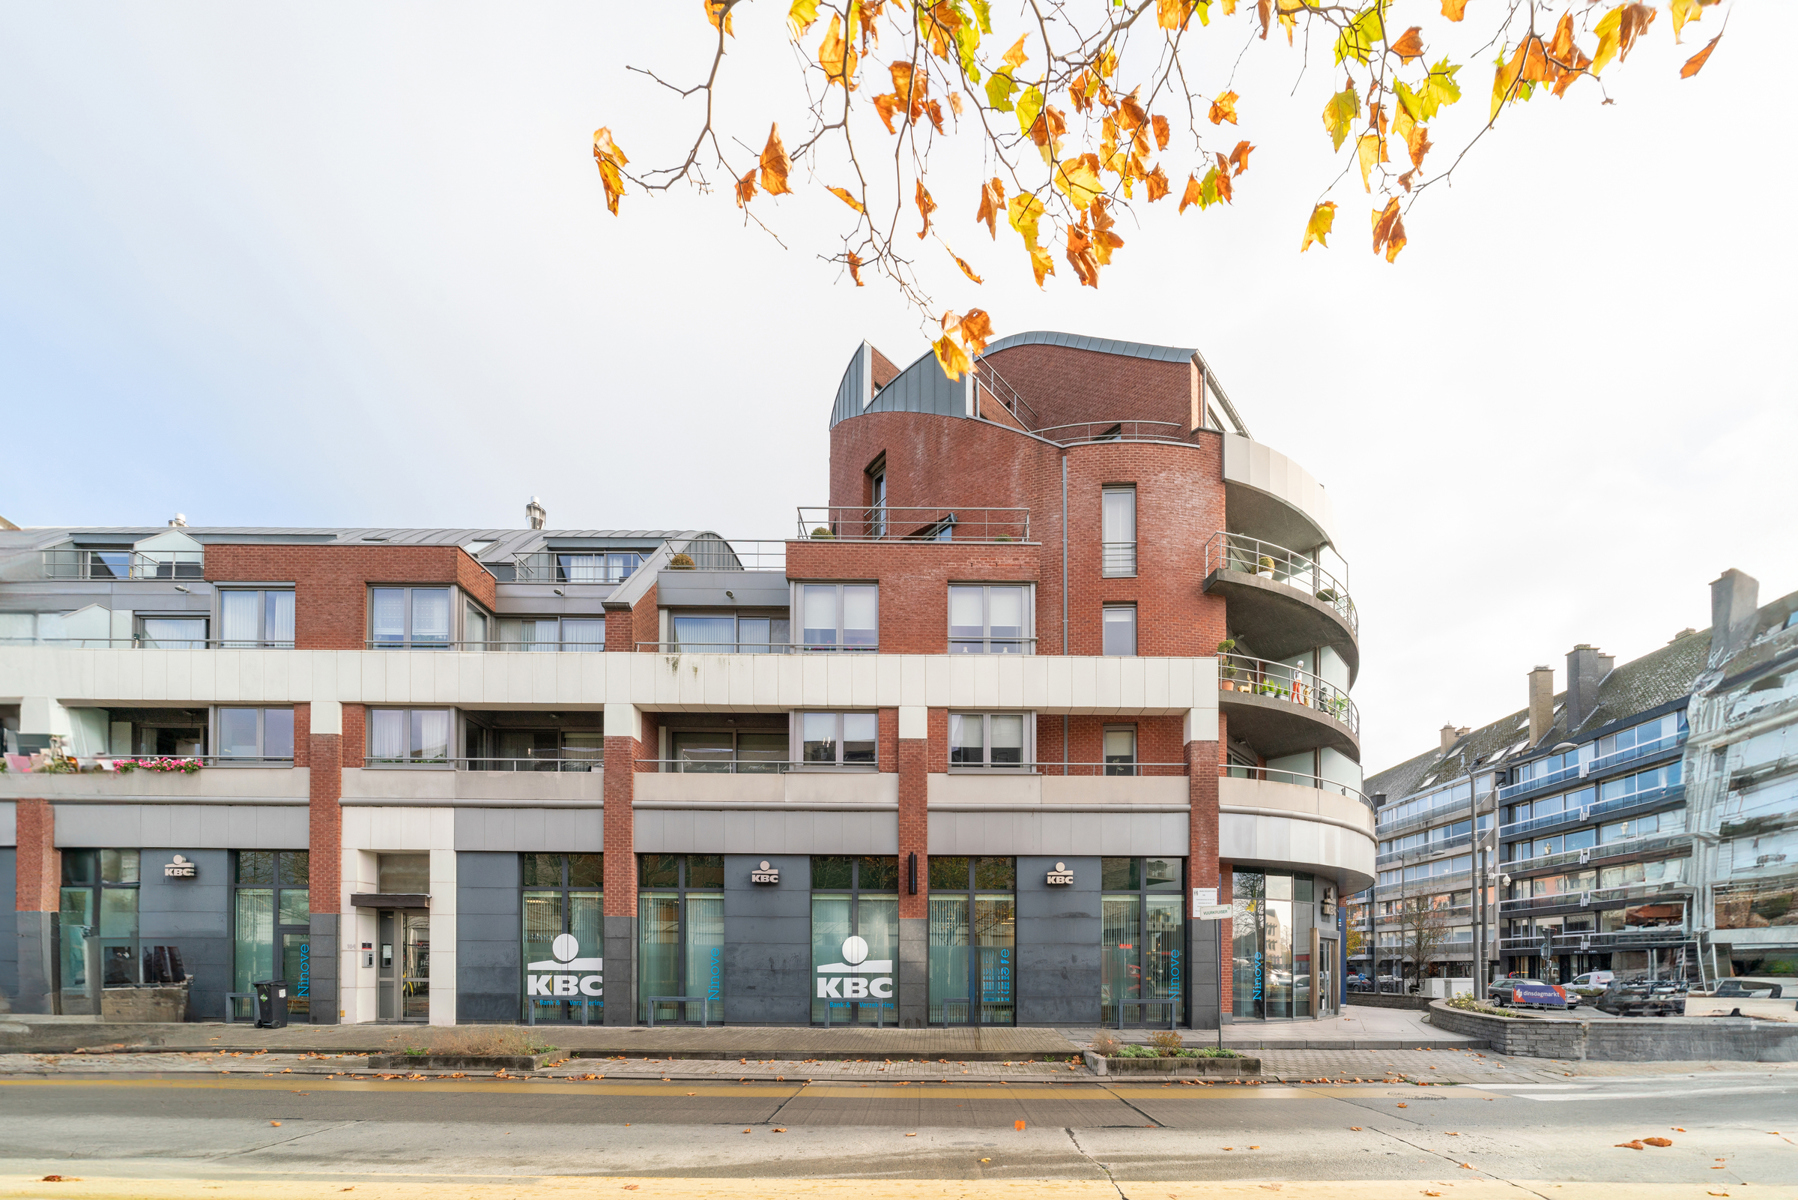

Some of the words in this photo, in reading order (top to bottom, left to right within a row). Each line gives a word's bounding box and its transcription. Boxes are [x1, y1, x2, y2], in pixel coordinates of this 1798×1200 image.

[164, 868, 195, 877] KBC
[751, 874, 779, 883] KBC
[1047, 875, 1074, 885] KBC
[297, 943, 310, 998] Ninove
[708, 947, 720, 1002] Ninove
[1168, 948, 1180, 1003] Ninove
[1252, 951, 1262, 1001] Ninove
[527, 974, 603, 997] KBC
[816, 976, 893, 999] KBC
[1523, 990, 1560, 998] dinsdagmarkt
[568, 999, 604, 1008] Verzering
[858, 1001, 894, 1010] Verzekring
